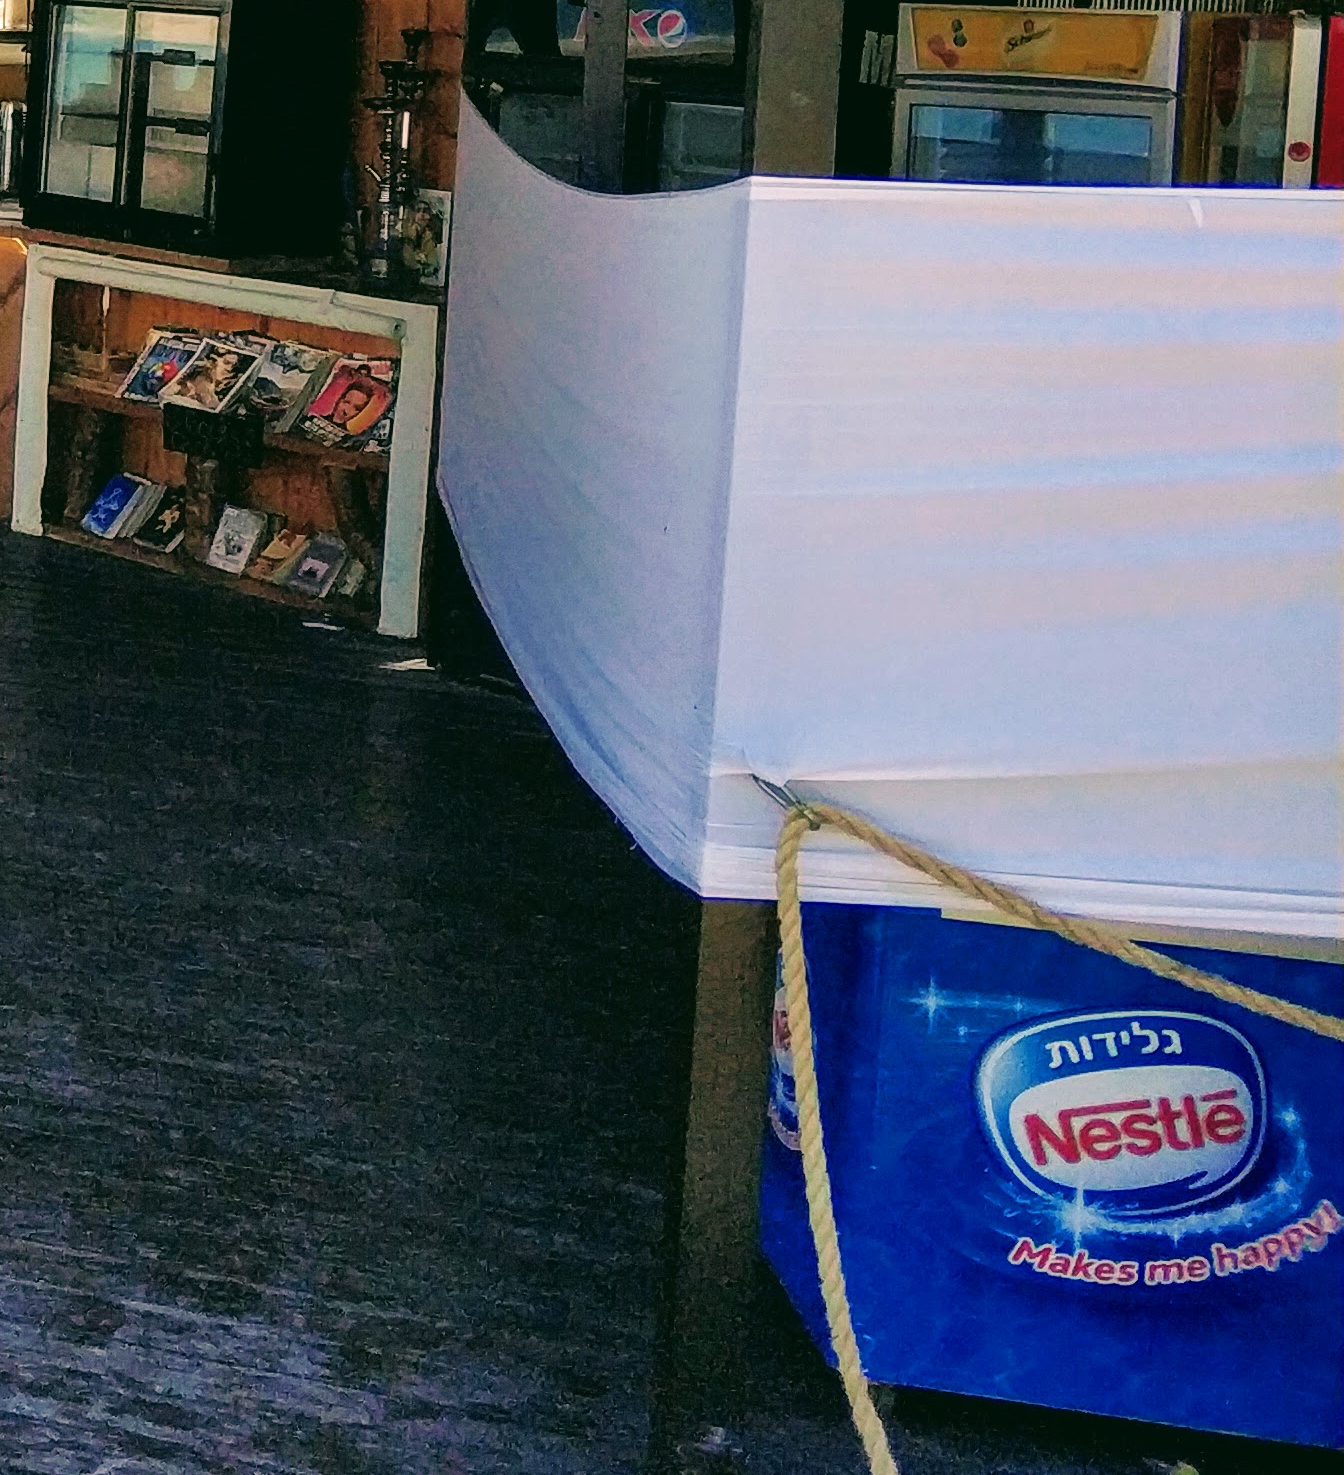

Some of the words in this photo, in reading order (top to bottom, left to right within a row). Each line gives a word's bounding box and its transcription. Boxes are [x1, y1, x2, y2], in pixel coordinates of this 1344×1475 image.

[1044, 1021, 1184, 1070] גלידות
[1022, 1088, 1248, 1167] Nestlé
[1011, 1238, 1139, 1284] Makes
[1145, 1256, 1210, 1285] me
